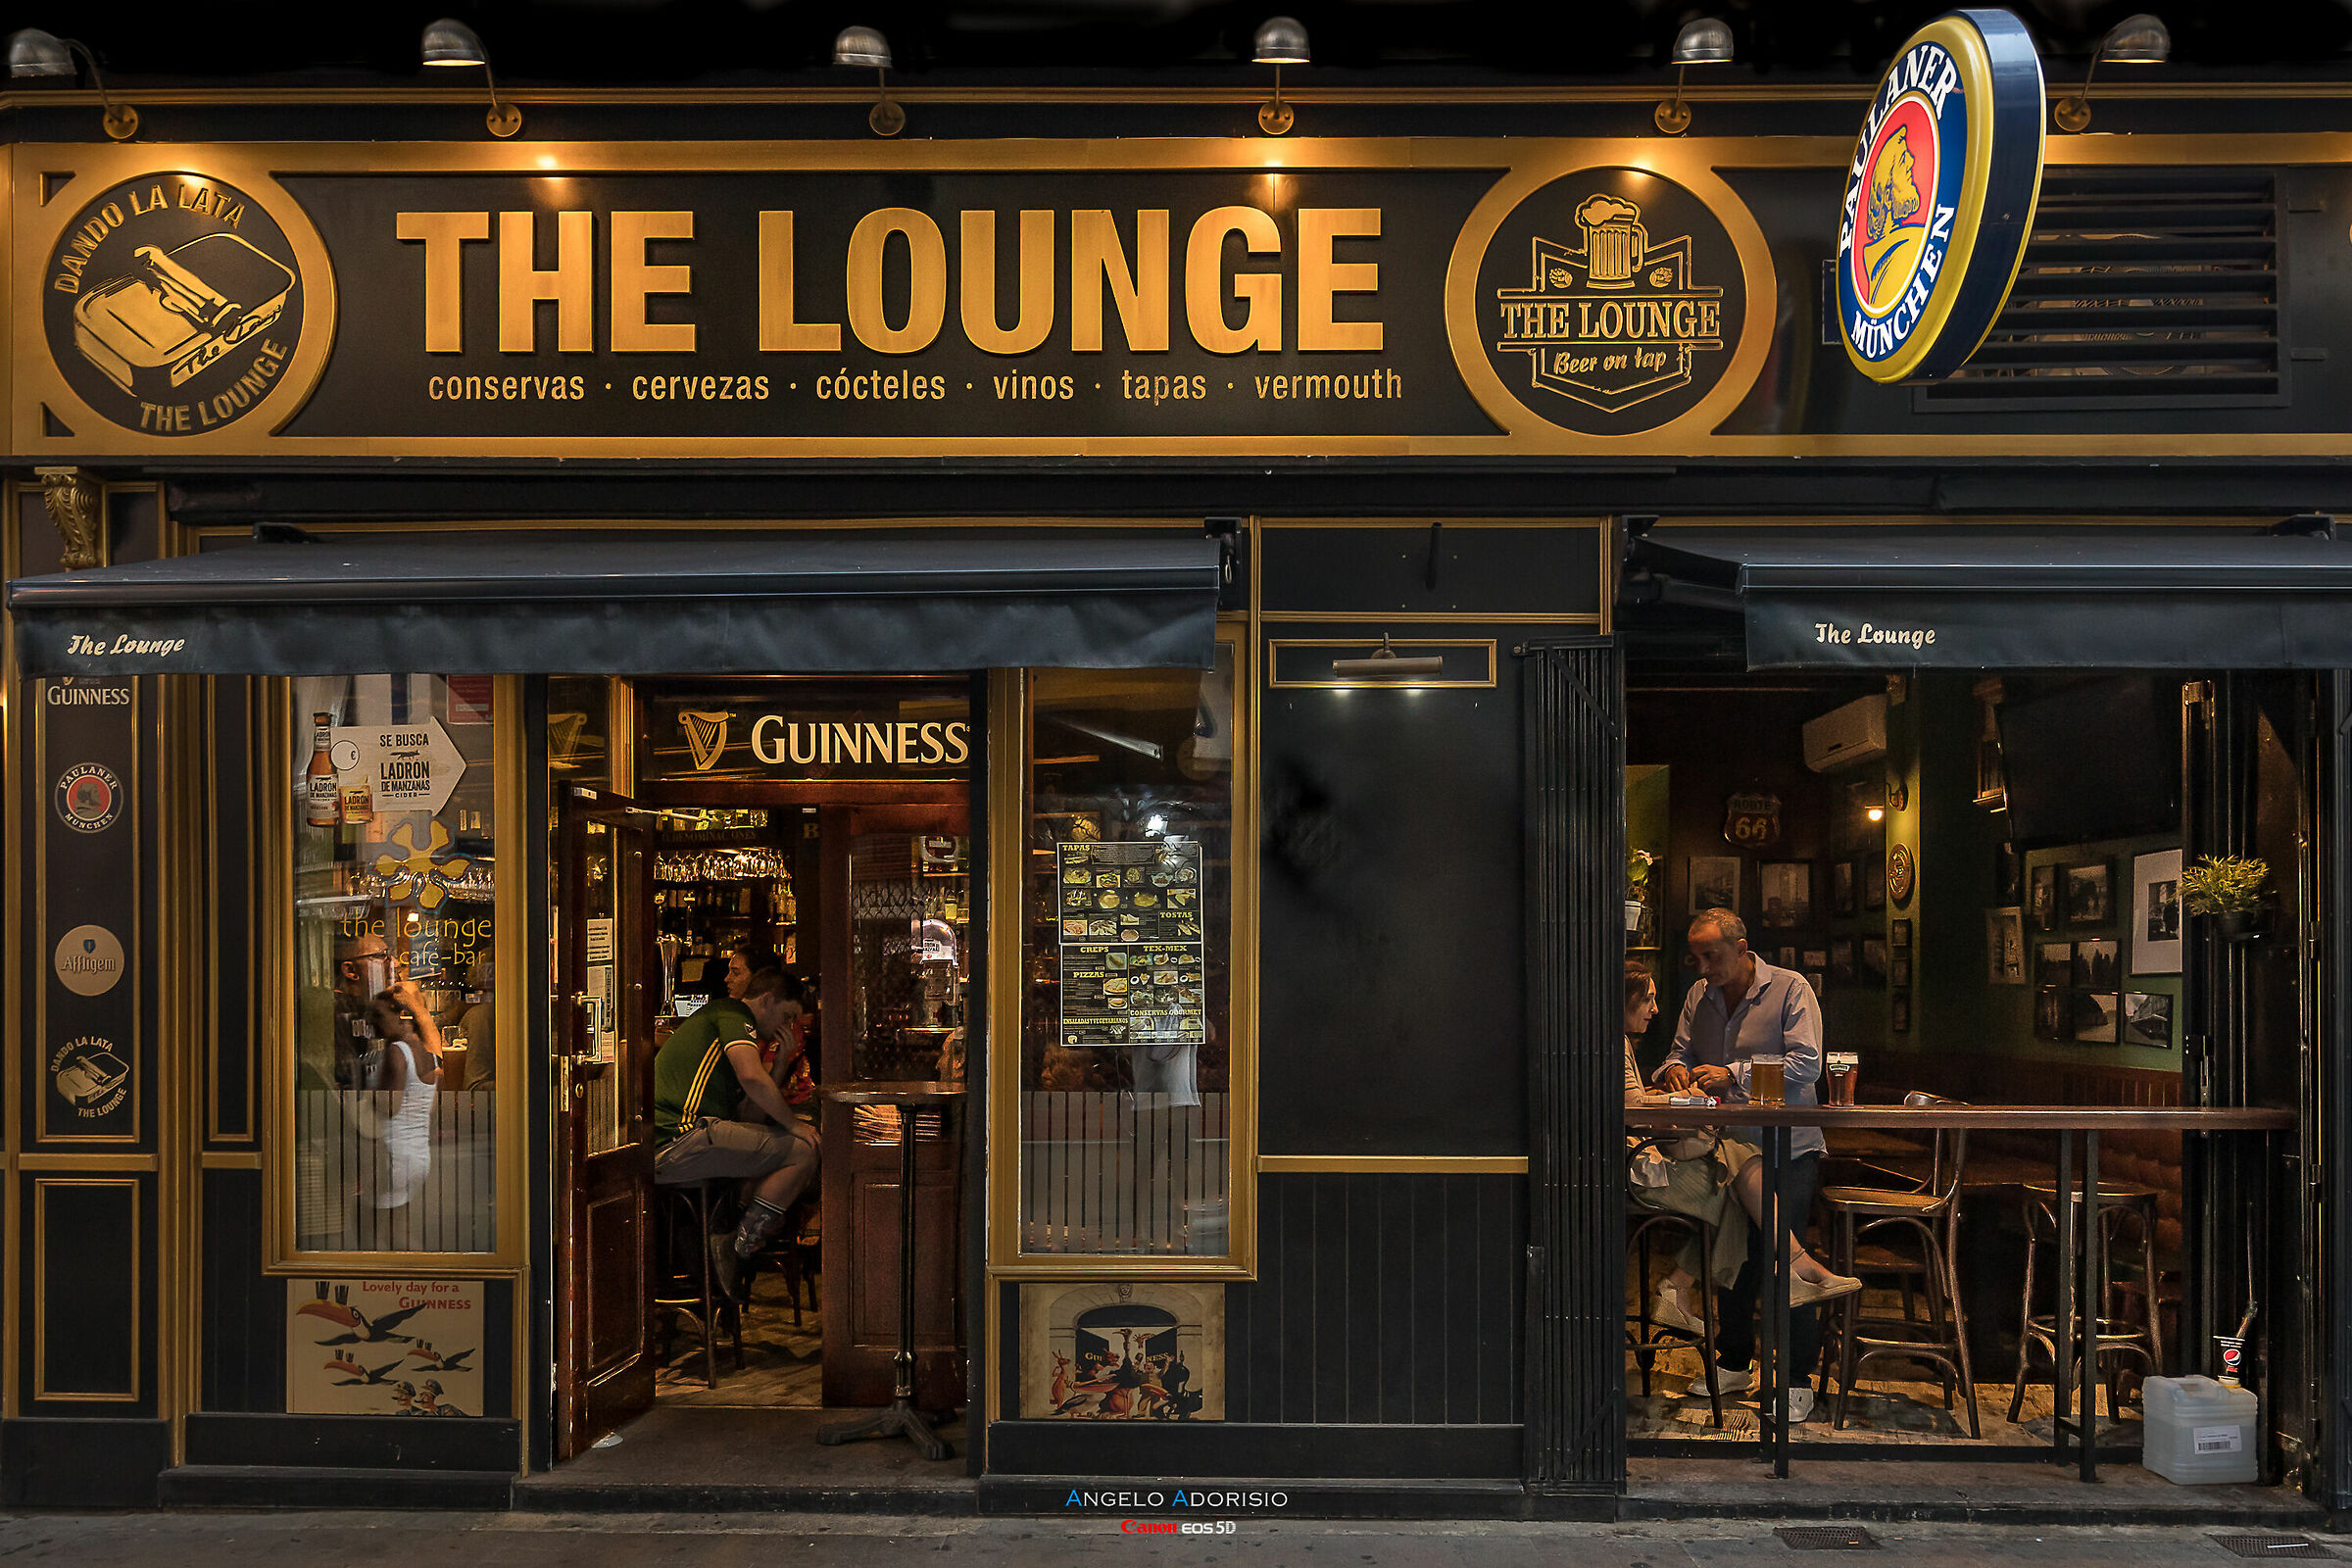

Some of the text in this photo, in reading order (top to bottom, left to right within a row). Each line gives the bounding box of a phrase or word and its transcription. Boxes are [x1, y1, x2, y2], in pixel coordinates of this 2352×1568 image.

[1839, 45, 1958, 257] PAULANER
[55, 184, 245, 294] DANDO LA LATA
[397, 206, 1384, 354] THE LOUNGE
[1851, 204, 1955, 359] MÜNCHEN
[1500, 300, 1721, 339] THE LOUNGE
[1553, 346, 1667, 374] Beer on tap
[139, 338, 288, 431] THE LOUNGE
[428, 368, 1402, 407] conservas cervezas cócteles vinos tapas vermouth
[67, 634, 185, 657] The Lounge
[1815, 622, 1936, 650] The Lounge
[47, 685, 130, 706] GUINNESS
[379, 733, 429, 747] SE BUSCA
[751, 715, 969, 763] GUINNESS
[60, 765, 118, 790] PAULANER
[380, 759, 430, 780] LADRÓN
[381, 779, 431, 792] DE MANZANAS
[339, 906, 492, 947] the lounge
[61, 956, 116, 974] Affligem
[50, 1036, 113, 1072] DANDO LA LATA
[78, 1087, 127, 1117] THE LOUNGE
[362, 1282, 403, 1296] Lovely
[406, 1282, 427, 1295] day
[431, 1281, 449, 1293] for
